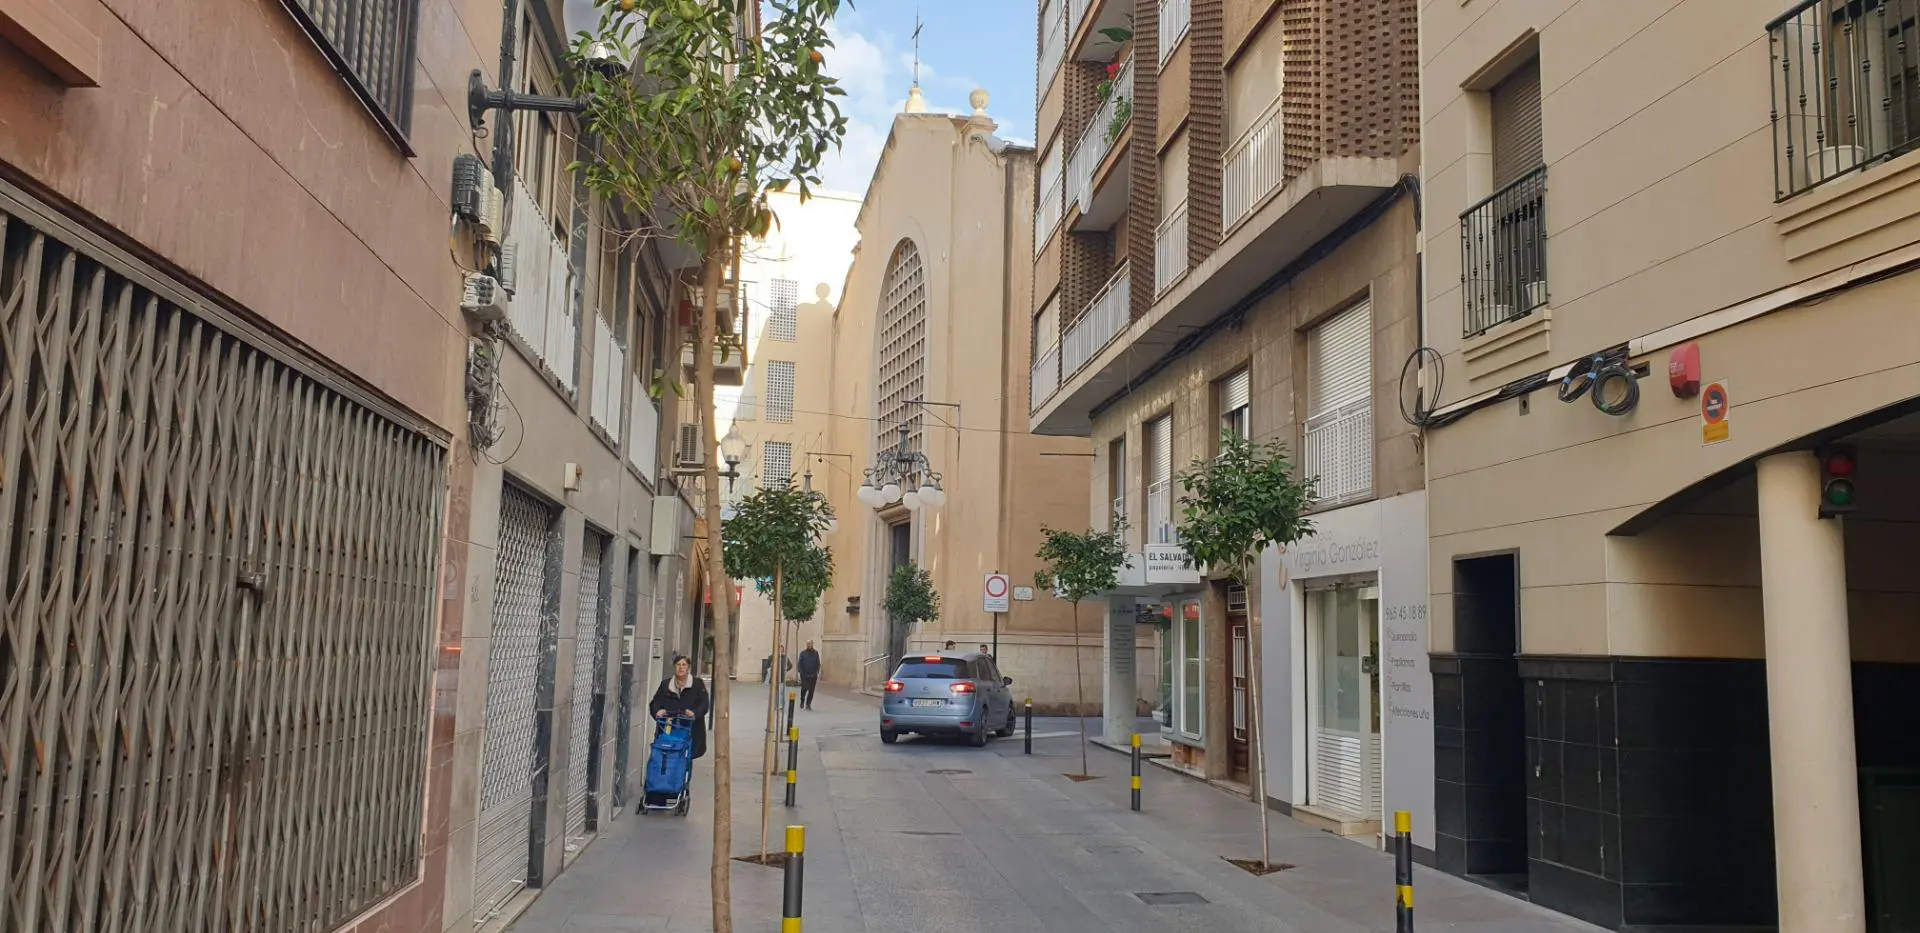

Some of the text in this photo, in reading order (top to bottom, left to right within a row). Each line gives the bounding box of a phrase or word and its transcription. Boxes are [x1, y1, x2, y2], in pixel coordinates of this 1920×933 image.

[1149, 552, 1158, 561] EL
[1292, 544, 1327, 572] Virginia
[1329, 536, 1379, 564] González
[1385, 604, 1427, 621] 965 45 18 89
